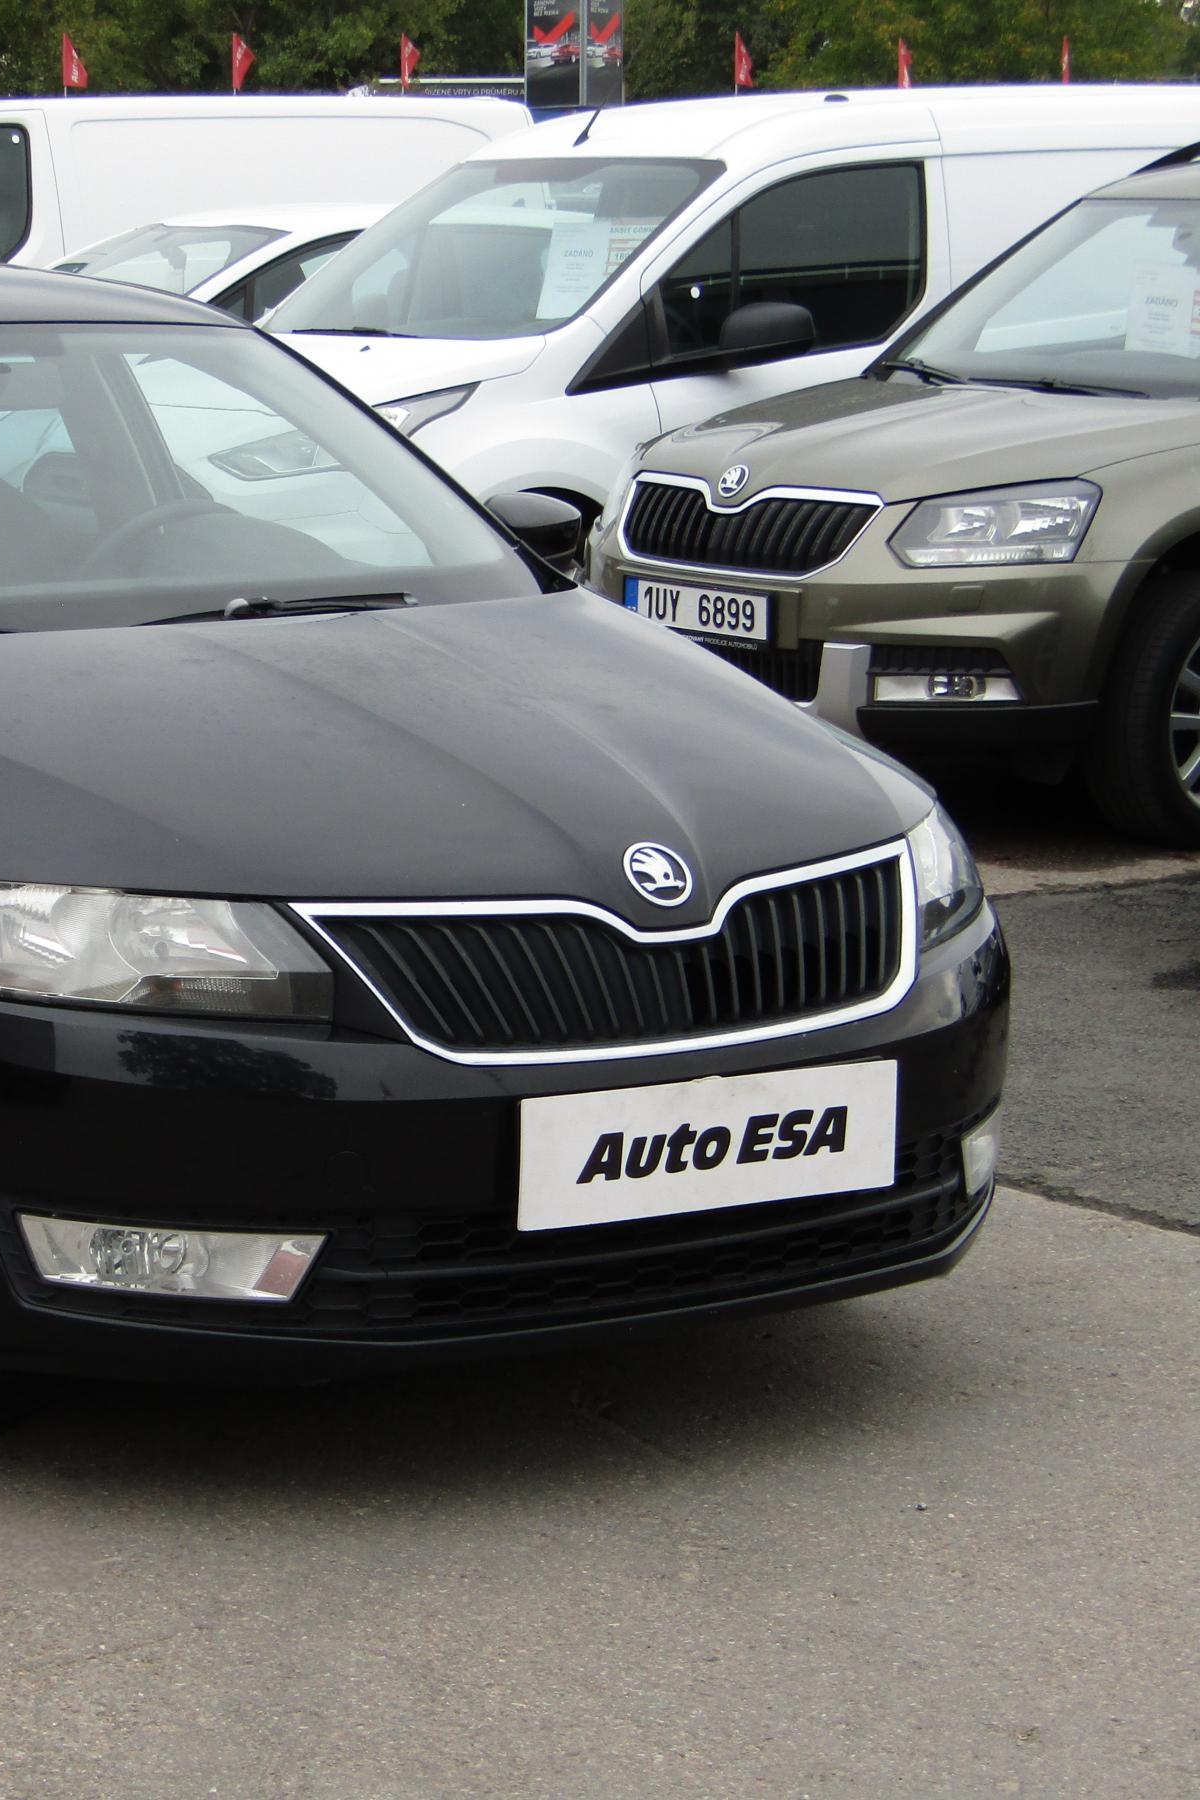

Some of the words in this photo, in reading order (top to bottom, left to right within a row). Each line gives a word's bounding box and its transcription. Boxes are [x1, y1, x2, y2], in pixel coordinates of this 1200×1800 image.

[644, 586, 680, 622] 1UY
[698, 594, 755, 632] 6899
[576, 1123, 731, 1184] Auto
[736, 1106, 848, 1164] ESA
